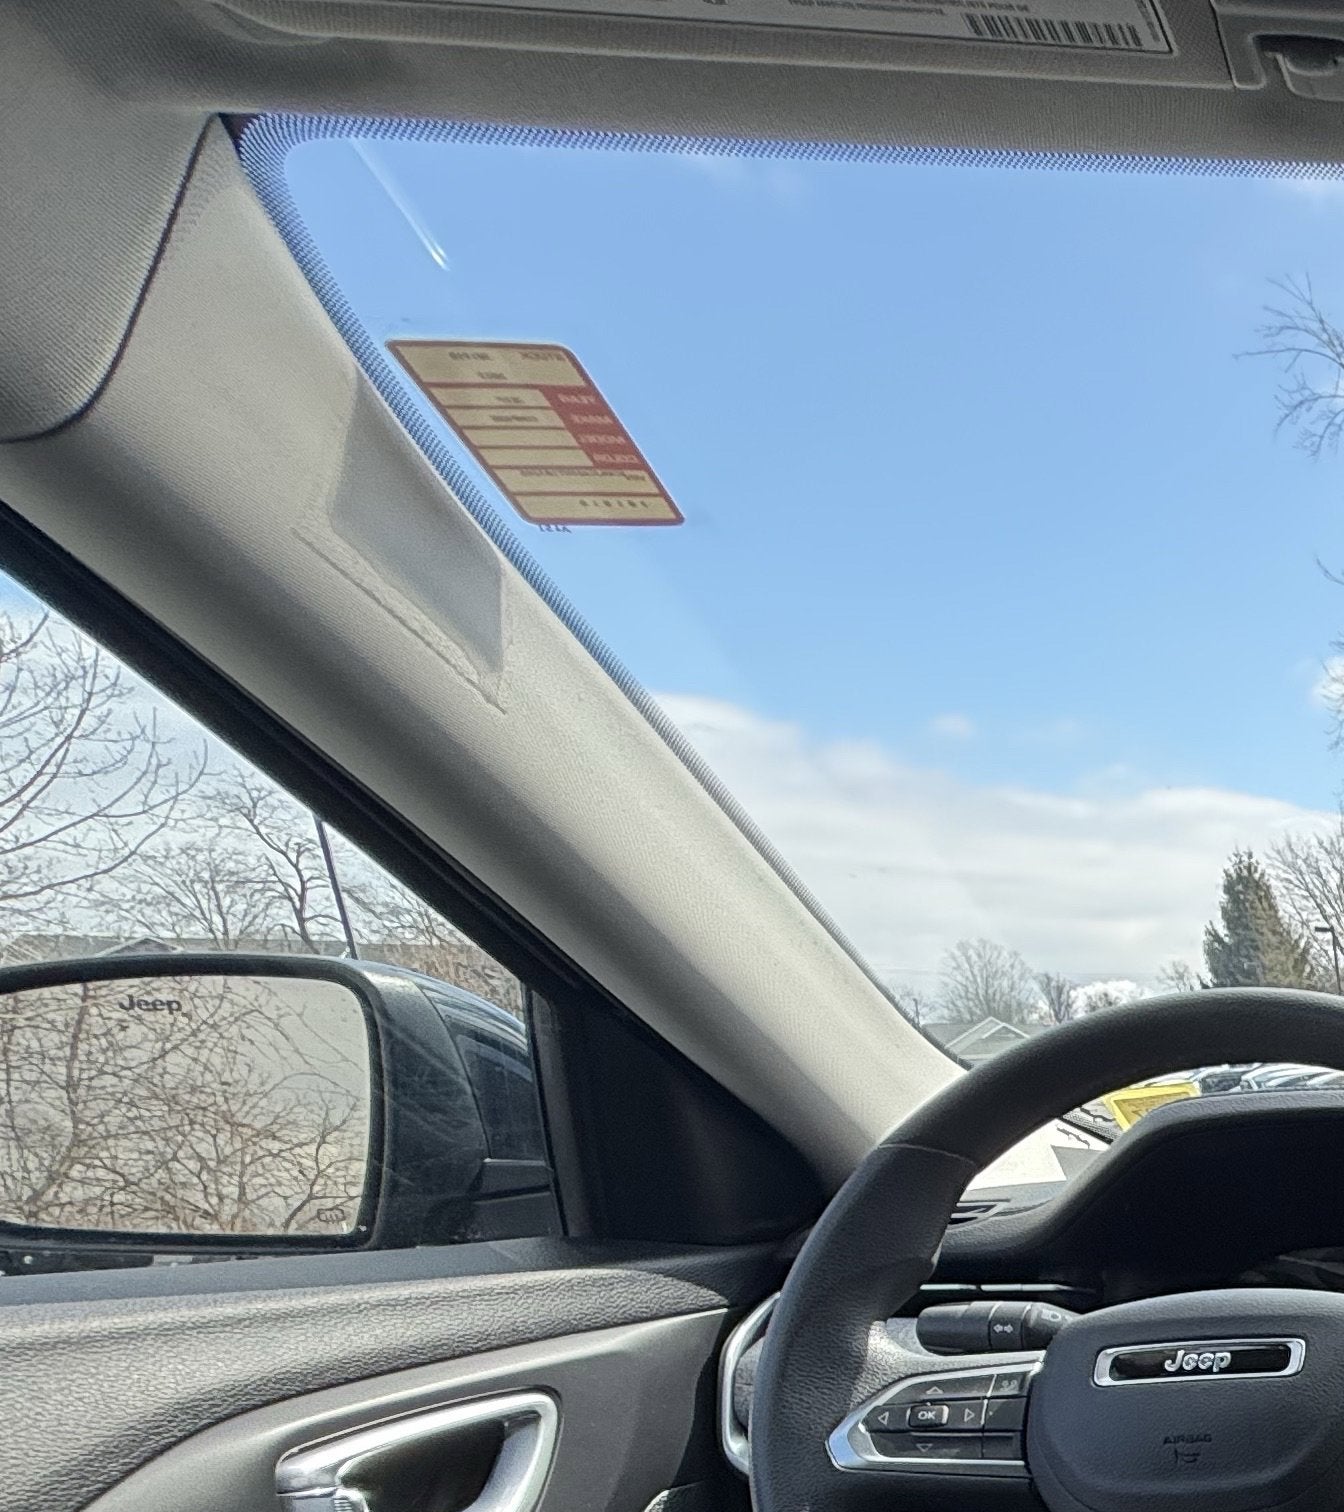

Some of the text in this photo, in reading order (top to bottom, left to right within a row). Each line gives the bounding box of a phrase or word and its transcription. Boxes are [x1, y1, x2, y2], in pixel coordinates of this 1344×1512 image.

[118, 994, 183, 1015] Jeep
[1164, 1349, 1232, 1373] Jeep
[917, 1410, 937, 1421] OK
[1163, 1434, 1213, 1445] AIRBAG
